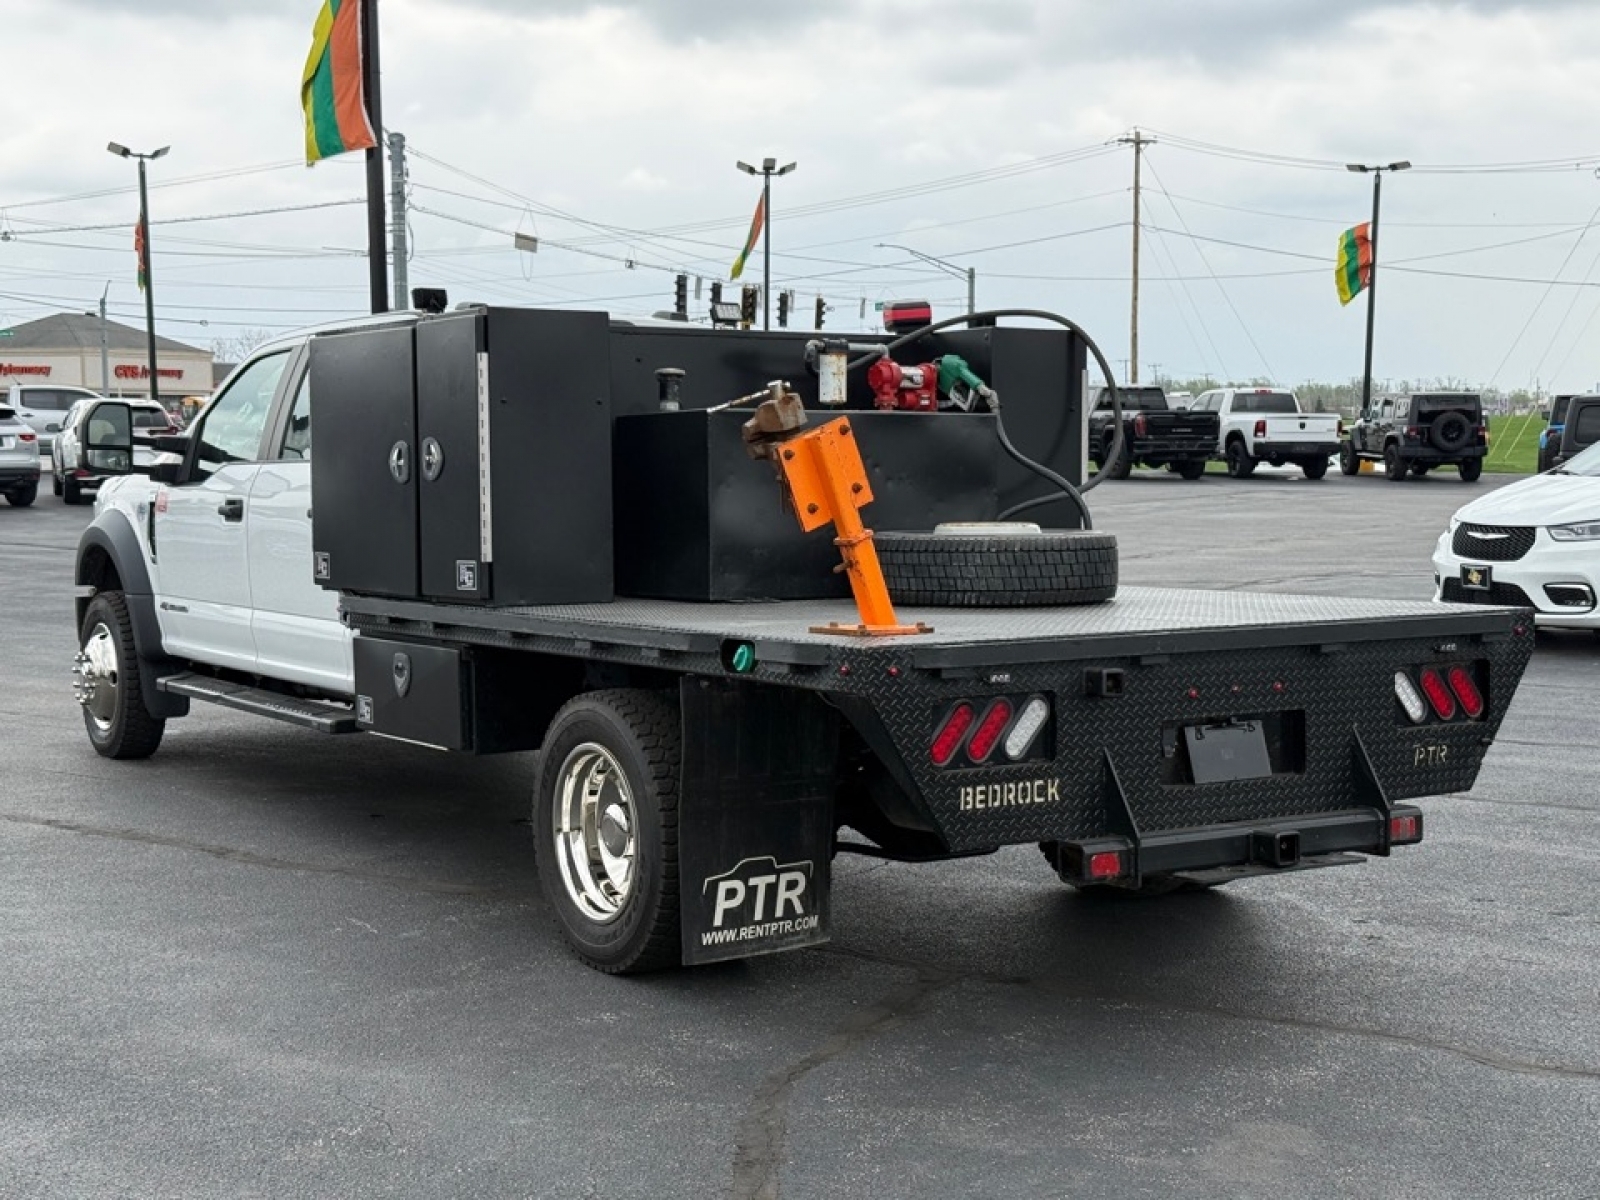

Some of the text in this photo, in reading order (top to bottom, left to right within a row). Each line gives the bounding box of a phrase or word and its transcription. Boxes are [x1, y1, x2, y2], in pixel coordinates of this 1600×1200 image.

[1414, 745, 1447, 766] PTR
[960, 778, 1060, 811] BEDROCK
[713, 871, 806, 928] PTR
[701, 914, 819, 946] WWW.RENTPTR.COM
